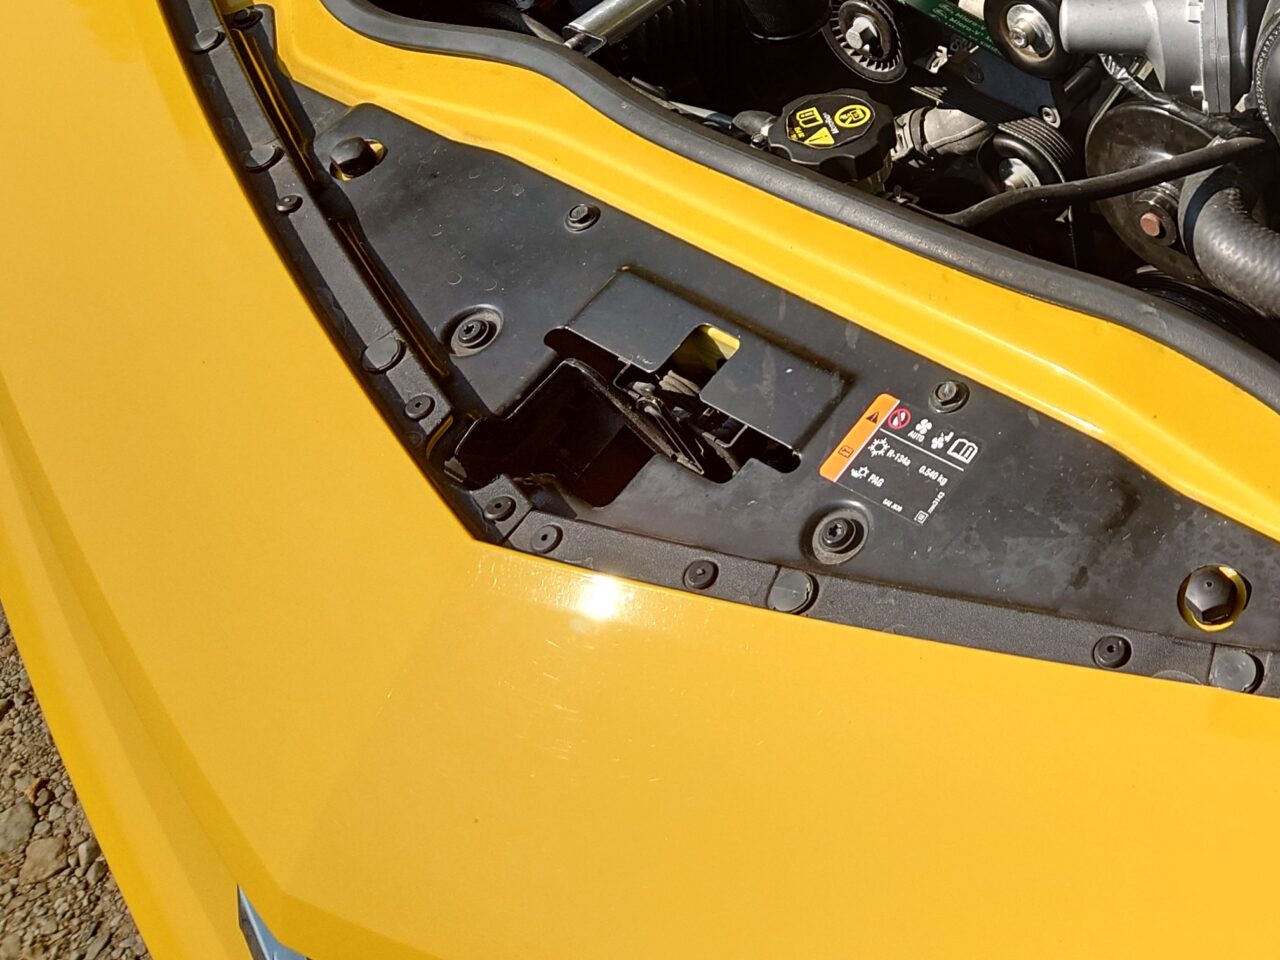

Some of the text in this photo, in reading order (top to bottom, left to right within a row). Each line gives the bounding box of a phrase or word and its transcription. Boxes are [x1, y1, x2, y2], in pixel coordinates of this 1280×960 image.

[907, 430, 925, 443] AUTO
[886, 449, 911, 466] R-134a
[919, 465, 939, 480] 0.540
[867, 473, 885, 487] PAG
